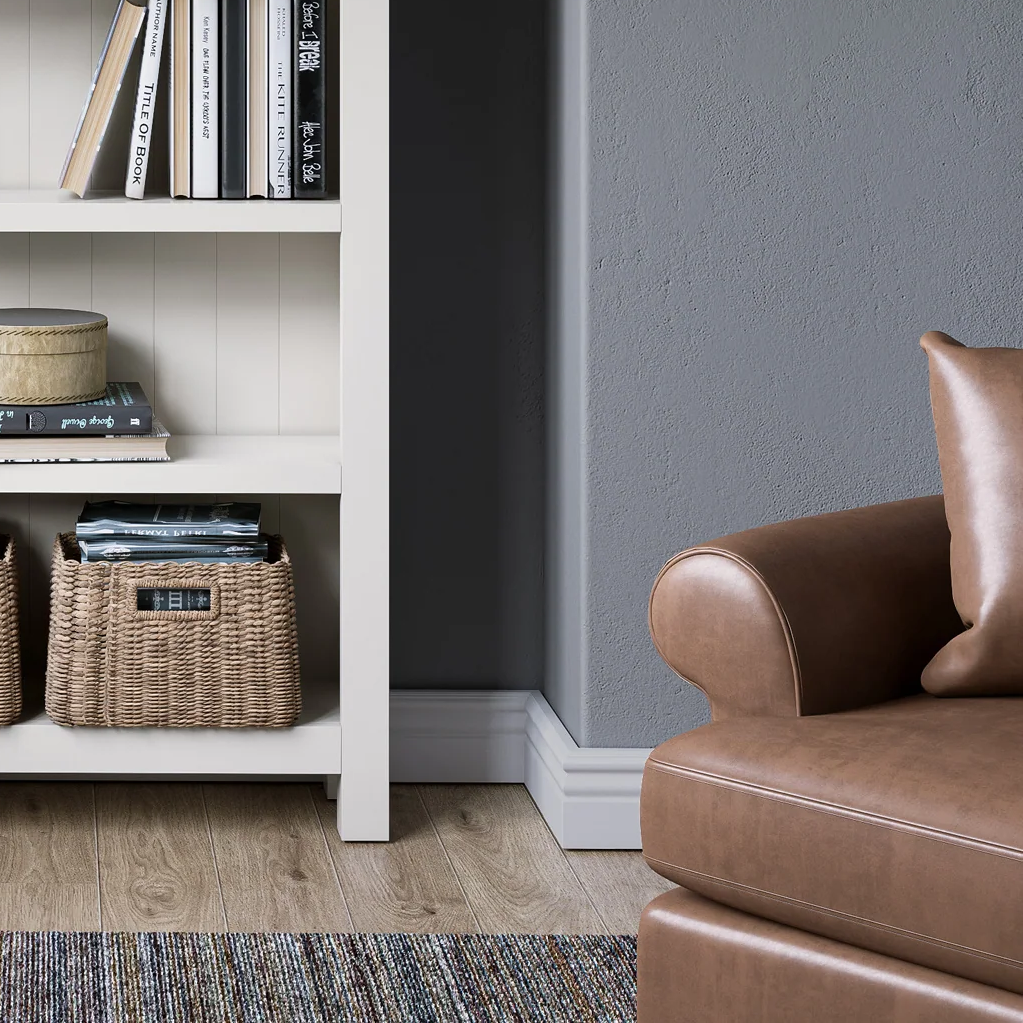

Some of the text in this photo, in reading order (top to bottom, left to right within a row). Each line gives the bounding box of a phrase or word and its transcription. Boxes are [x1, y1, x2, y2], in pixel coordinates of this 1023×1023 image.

[149, 32, 158, 57] NAME
[201, 27, 210, 43] Kesey
[298, 1, 321, 72] Before I Break
[277, 83, 285, 121] KITE
[133, 83, 154, 186] TITLE OF BOOK
[301, 121, 321, 184] Alec John Belle
[277, 126, 285, 195] RUNNER
[5, 411, 14, 421] in
[60, 416, 115, 429] George Orwell
